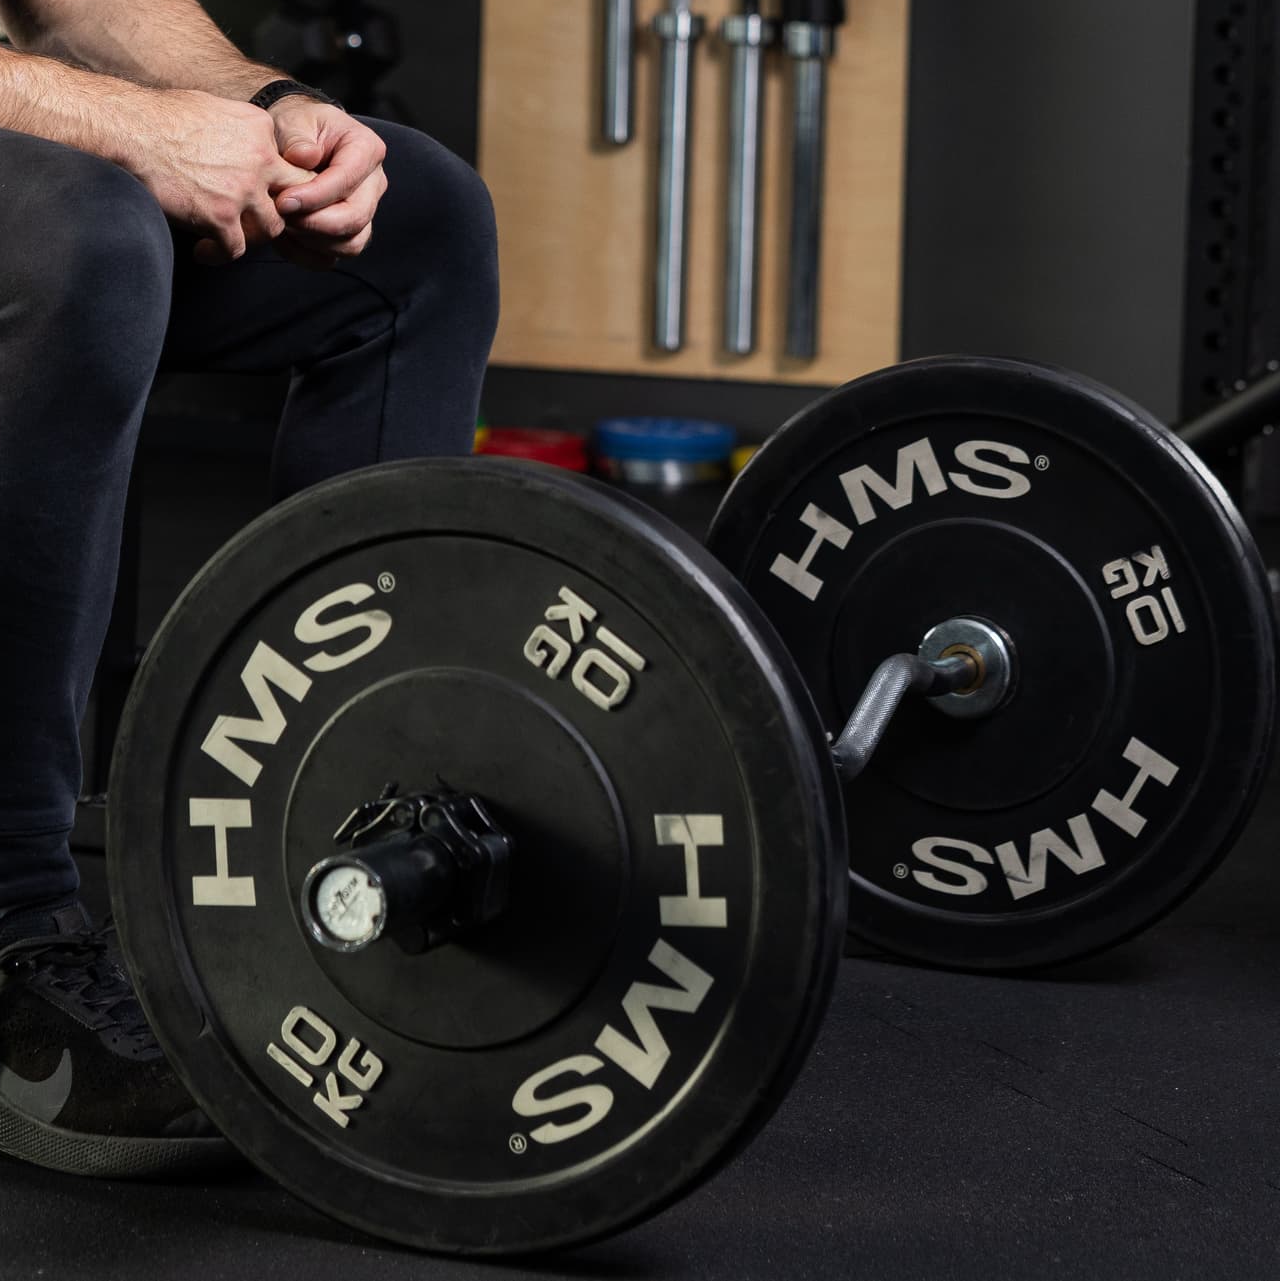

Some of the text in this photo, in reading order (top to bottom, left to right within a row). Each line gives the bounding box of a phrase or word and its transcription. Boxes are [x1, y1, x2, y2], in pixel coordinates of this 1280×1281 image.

[1101, 545, 1173, 600] KG
[523, 586, 598, 680] KG
[1125, 586, 1187, 646] 10
[571, 625, 646, 712] 10
[266, 1005, 337, 1088] 10
[312, 1038, 384, 1129] KG
